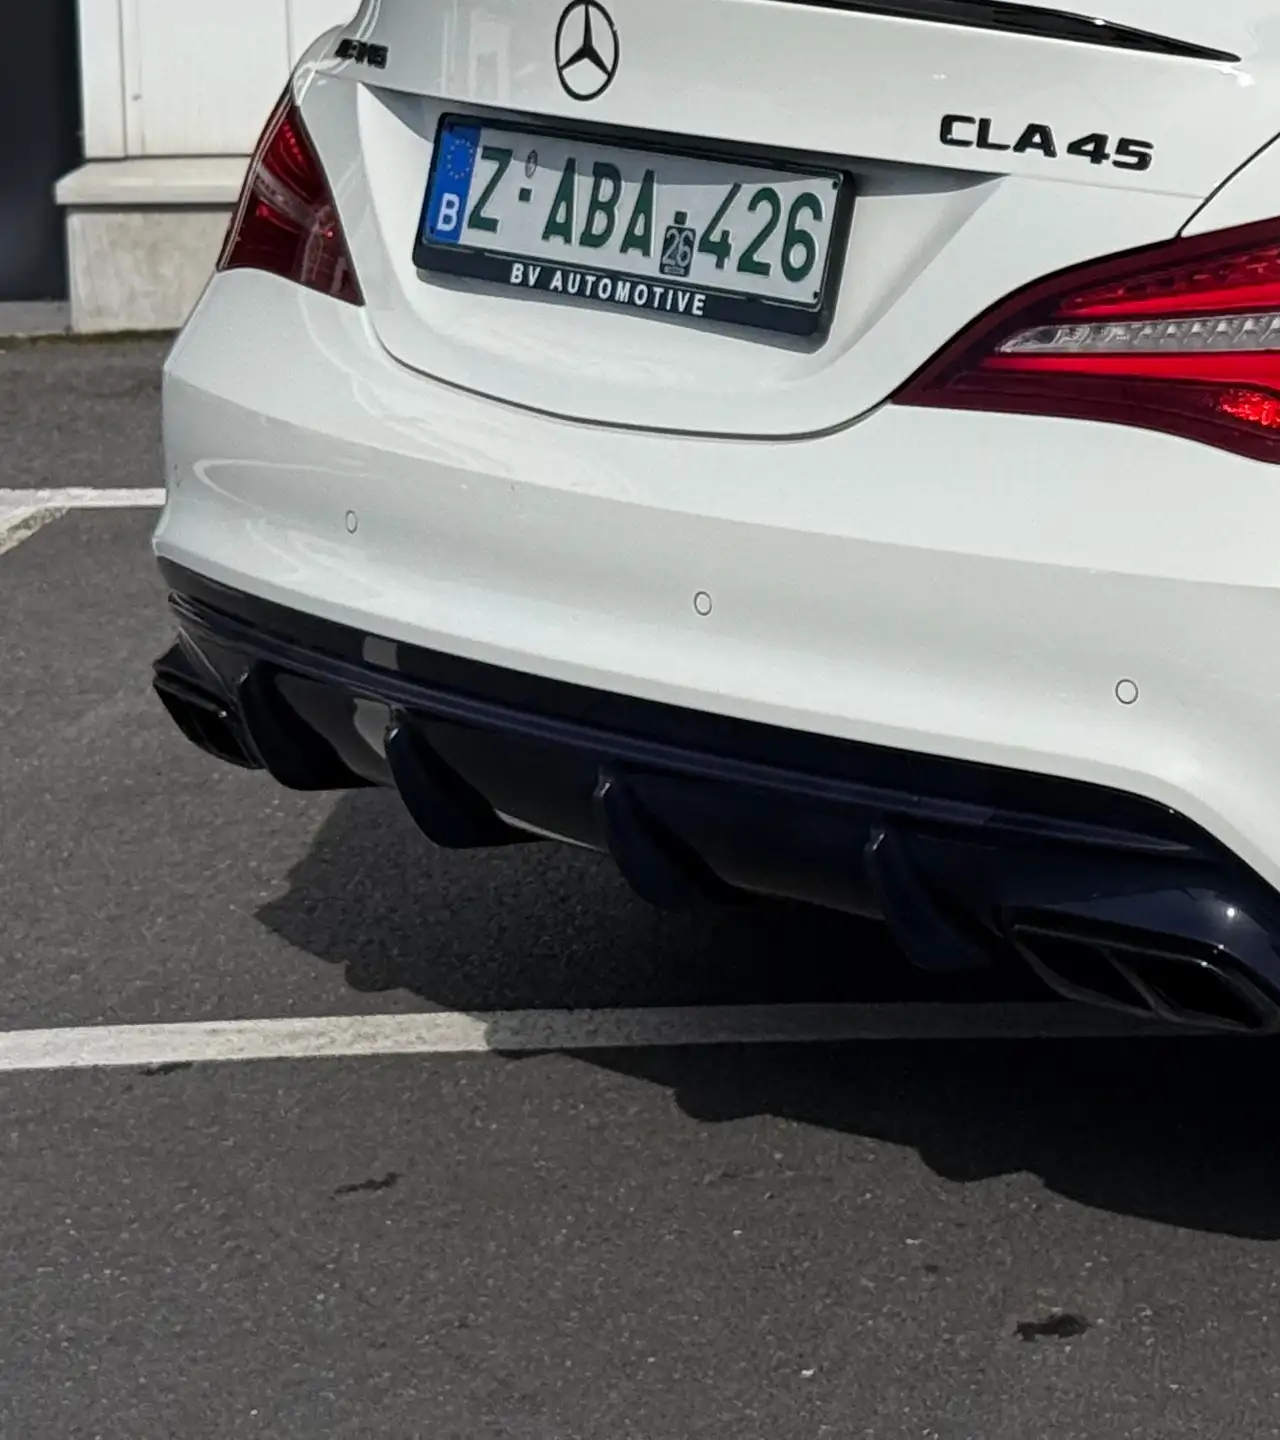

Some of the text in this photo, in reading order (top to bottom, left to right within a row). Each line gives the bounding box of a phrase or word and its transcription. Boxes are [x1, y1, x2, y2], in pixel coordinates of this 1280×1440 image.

[939, 113, 1155, 172] CLA 45
[436, 192, 461, 232] B
[509, 262, 708, 316] BV AUTOMOTIVE
